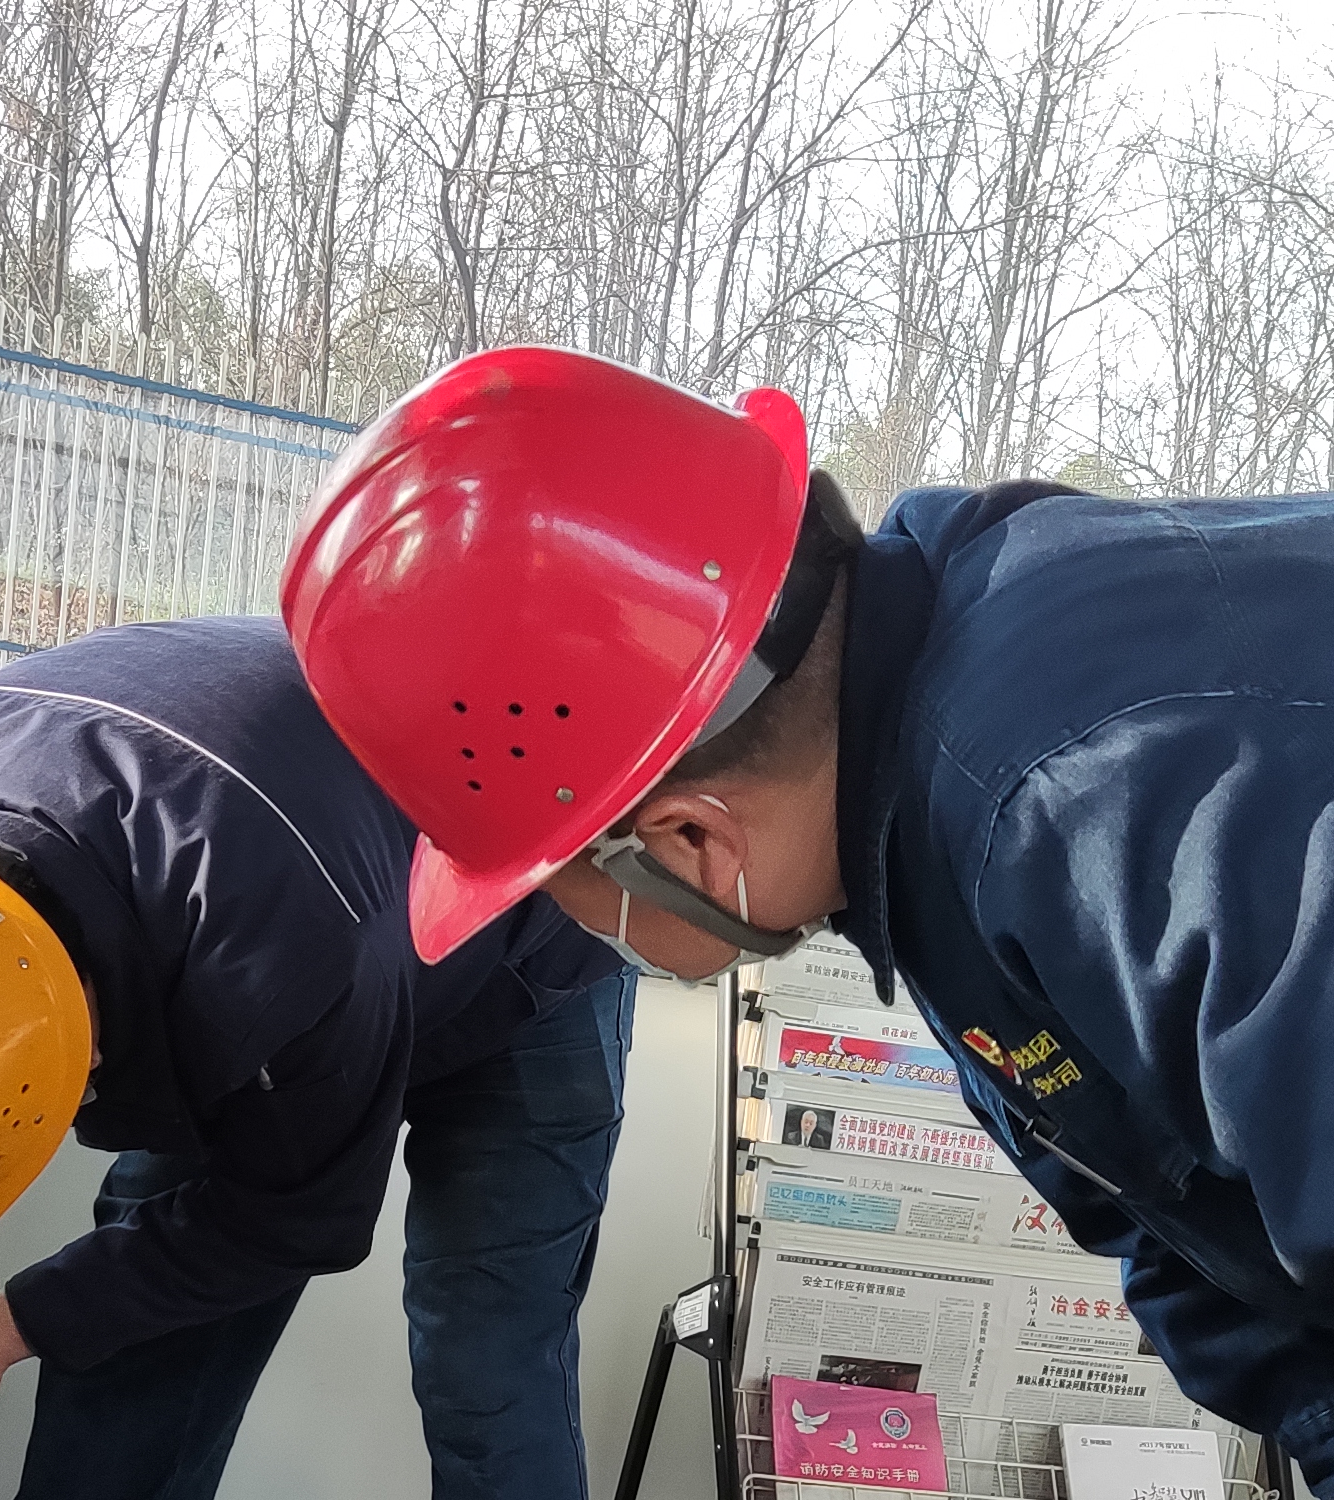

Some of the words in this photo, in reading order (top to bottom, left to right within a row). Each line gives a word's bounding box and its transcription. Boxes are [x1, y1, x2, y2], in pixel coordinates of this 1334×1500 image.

[895, 1063, 960, 1087] 百年初心历
[839, 1113, 916, 1142] 全面加强党的建设
[847, 1174, 894, 1193] 员工天地
[802, 1275, 907, 1299] 安全工作应有管理痕迹
[799, 1461, 920, 1483] 消防安全知识手册
